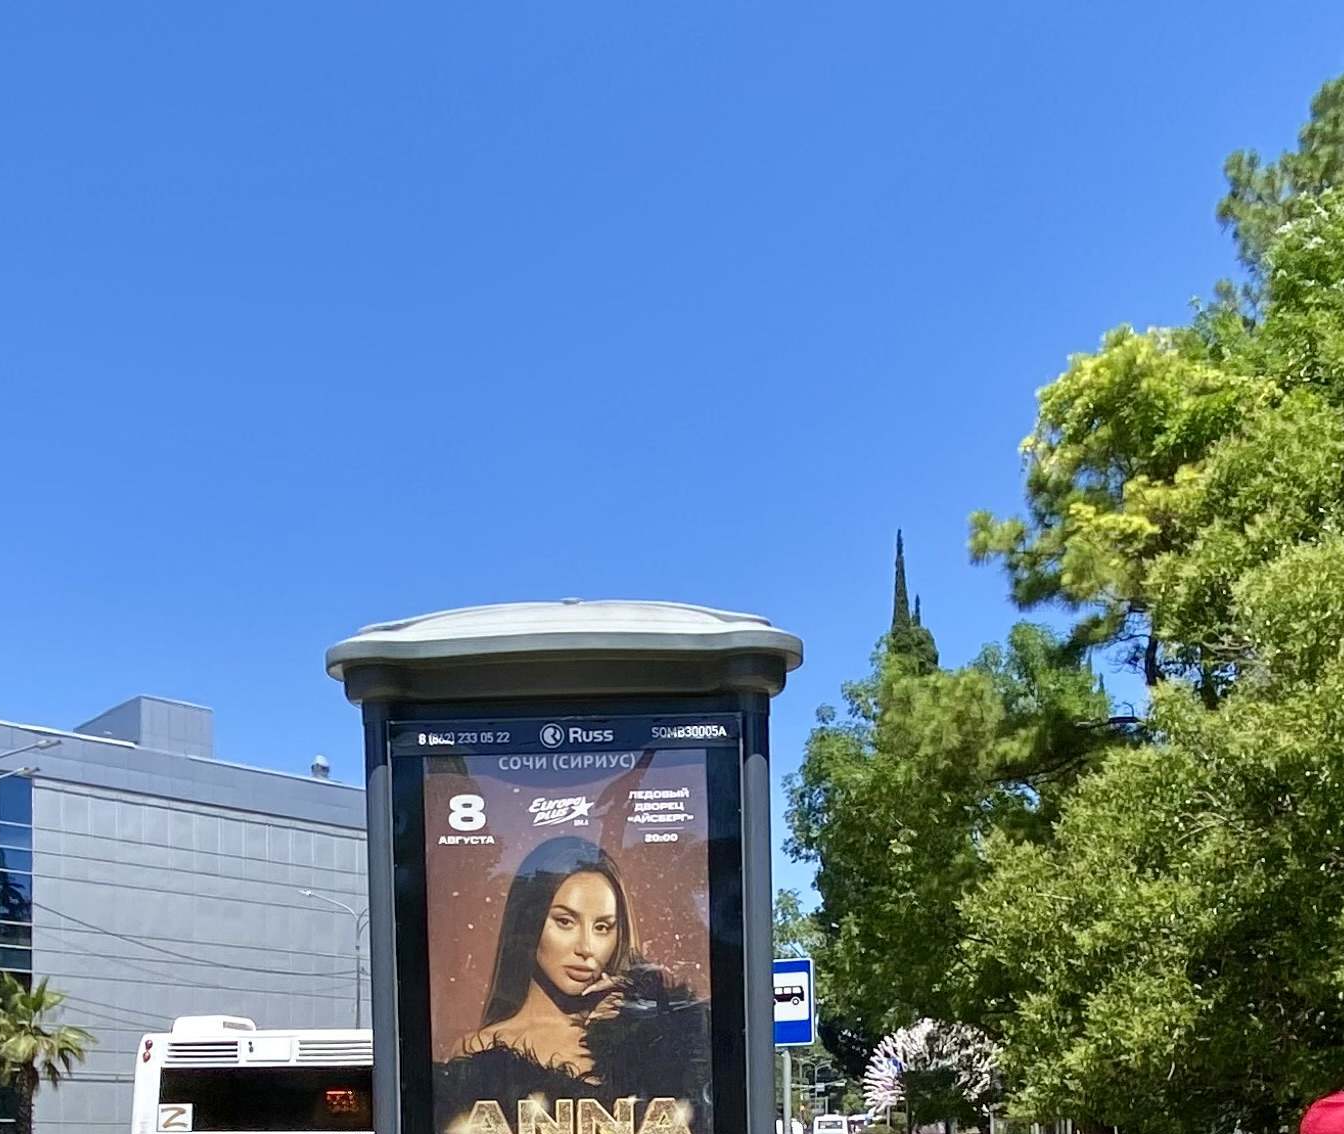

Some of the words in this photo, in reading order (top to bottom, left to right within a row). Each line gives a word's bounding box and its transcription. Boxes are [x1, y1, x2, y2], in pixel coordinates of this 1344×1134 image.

[418, 733, 427, 745] 8
[457, 731, 478, 744] 233
[480, 731, 494, 744] 05
[496, 731, 511, 744] 22
[569, 727, 614, 743] Russ
[498, 756, 547, 770] СОЧИ
[552, 752, 636, 771] (СИРИУС)
[628, 788, 690, 800] ЛЕДОВЫЙ
[448, 794, 487, 831] 8
[634, 802, 685, 812] ДВОРЕЦ
[627, 813, 694, 823] «АЙСБЕРГ»
[438, 836, 495, 845] АВГУСТА
[644, 833, 678, 843] 20:00
[161, 1106, 188, 1129] Z
